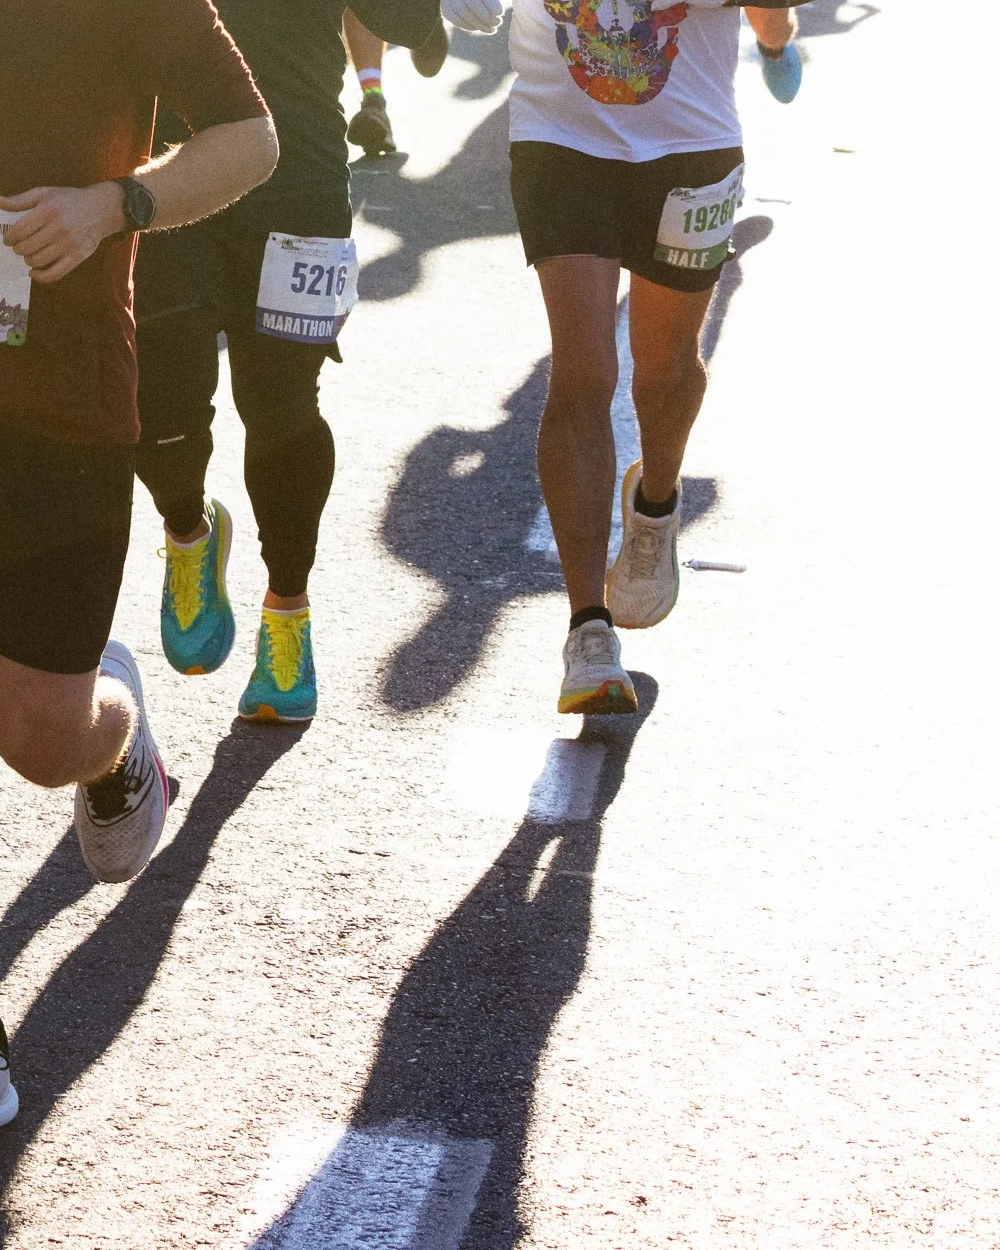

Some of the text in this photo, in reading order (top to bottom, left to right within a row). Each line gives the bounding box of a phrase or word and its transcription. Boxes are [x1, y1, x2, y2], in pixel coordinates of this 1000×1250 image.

[666, 249, 710, 268] HALF
[290, 261, 348, 296] 5216
[262, 312, 334, 337] MARATHON
